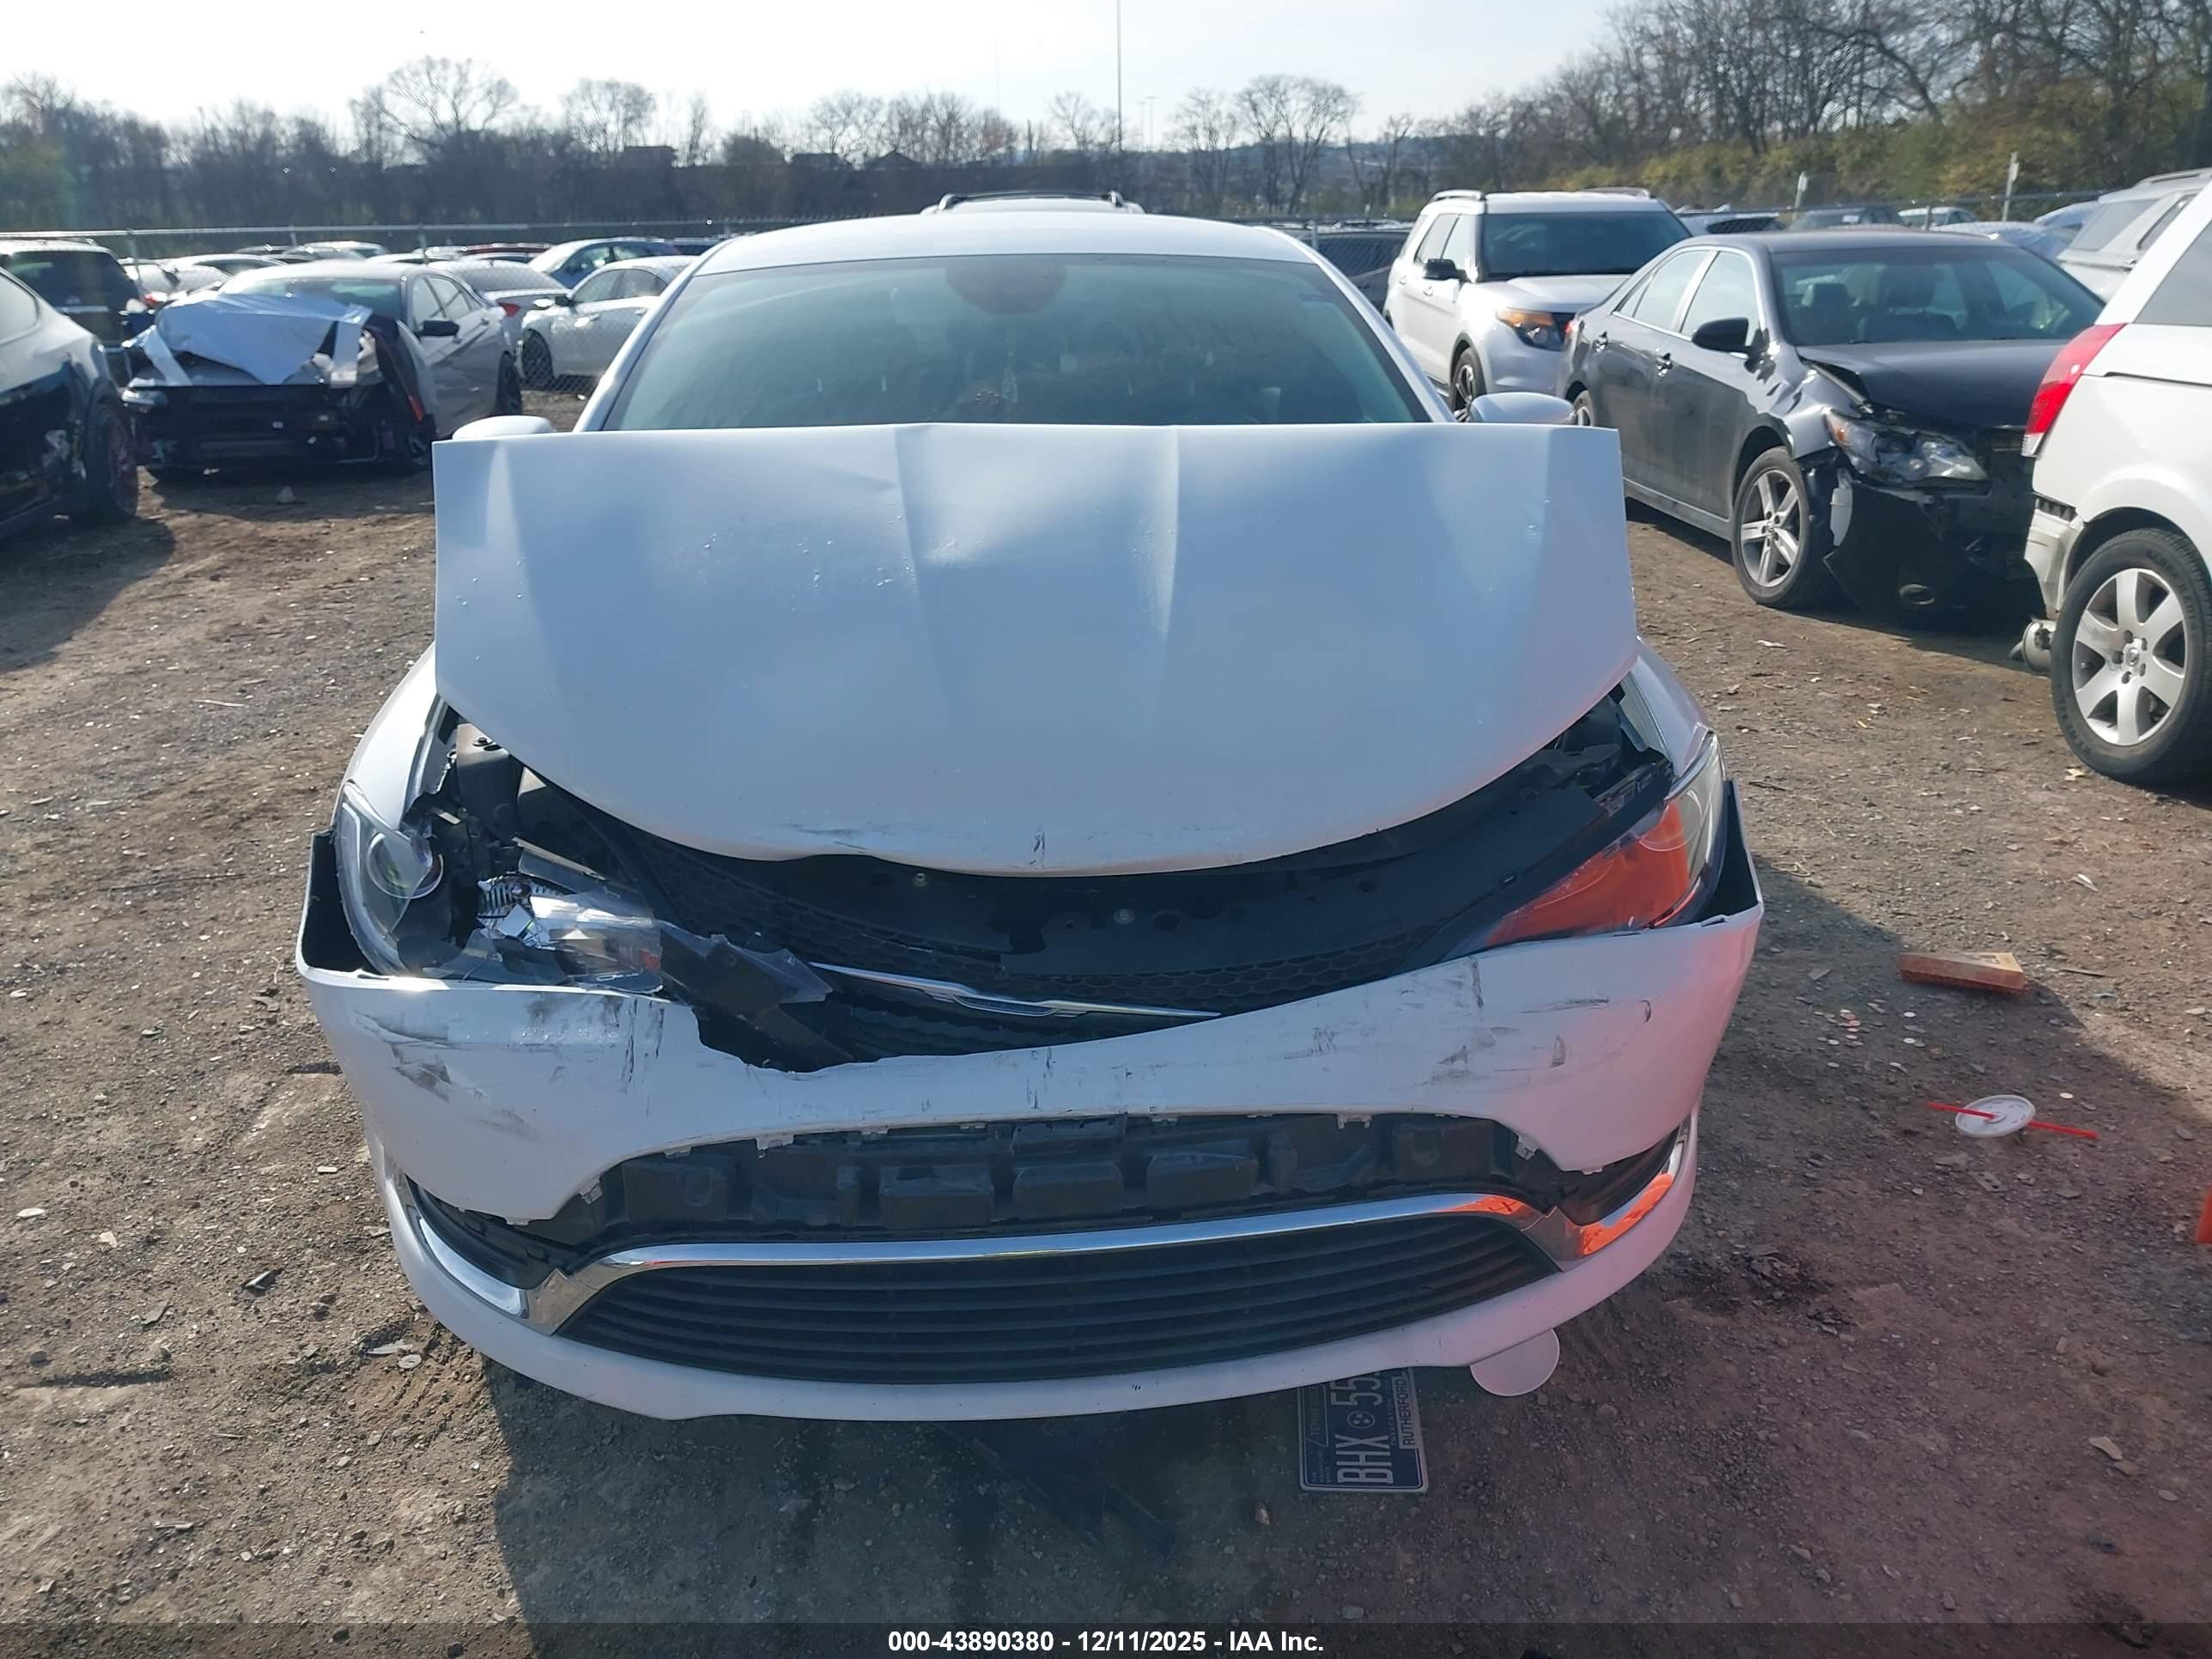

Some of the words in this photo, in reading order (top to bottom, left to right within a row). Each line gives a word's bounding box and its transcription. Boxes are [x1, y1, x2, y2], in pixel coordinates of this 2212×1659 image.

[1330, 1372, 1383, 1406] 55
[1395, 1379, 1416, 1445] RUTHERFORD
[1334, 1434, 1394, 1484] BHX
